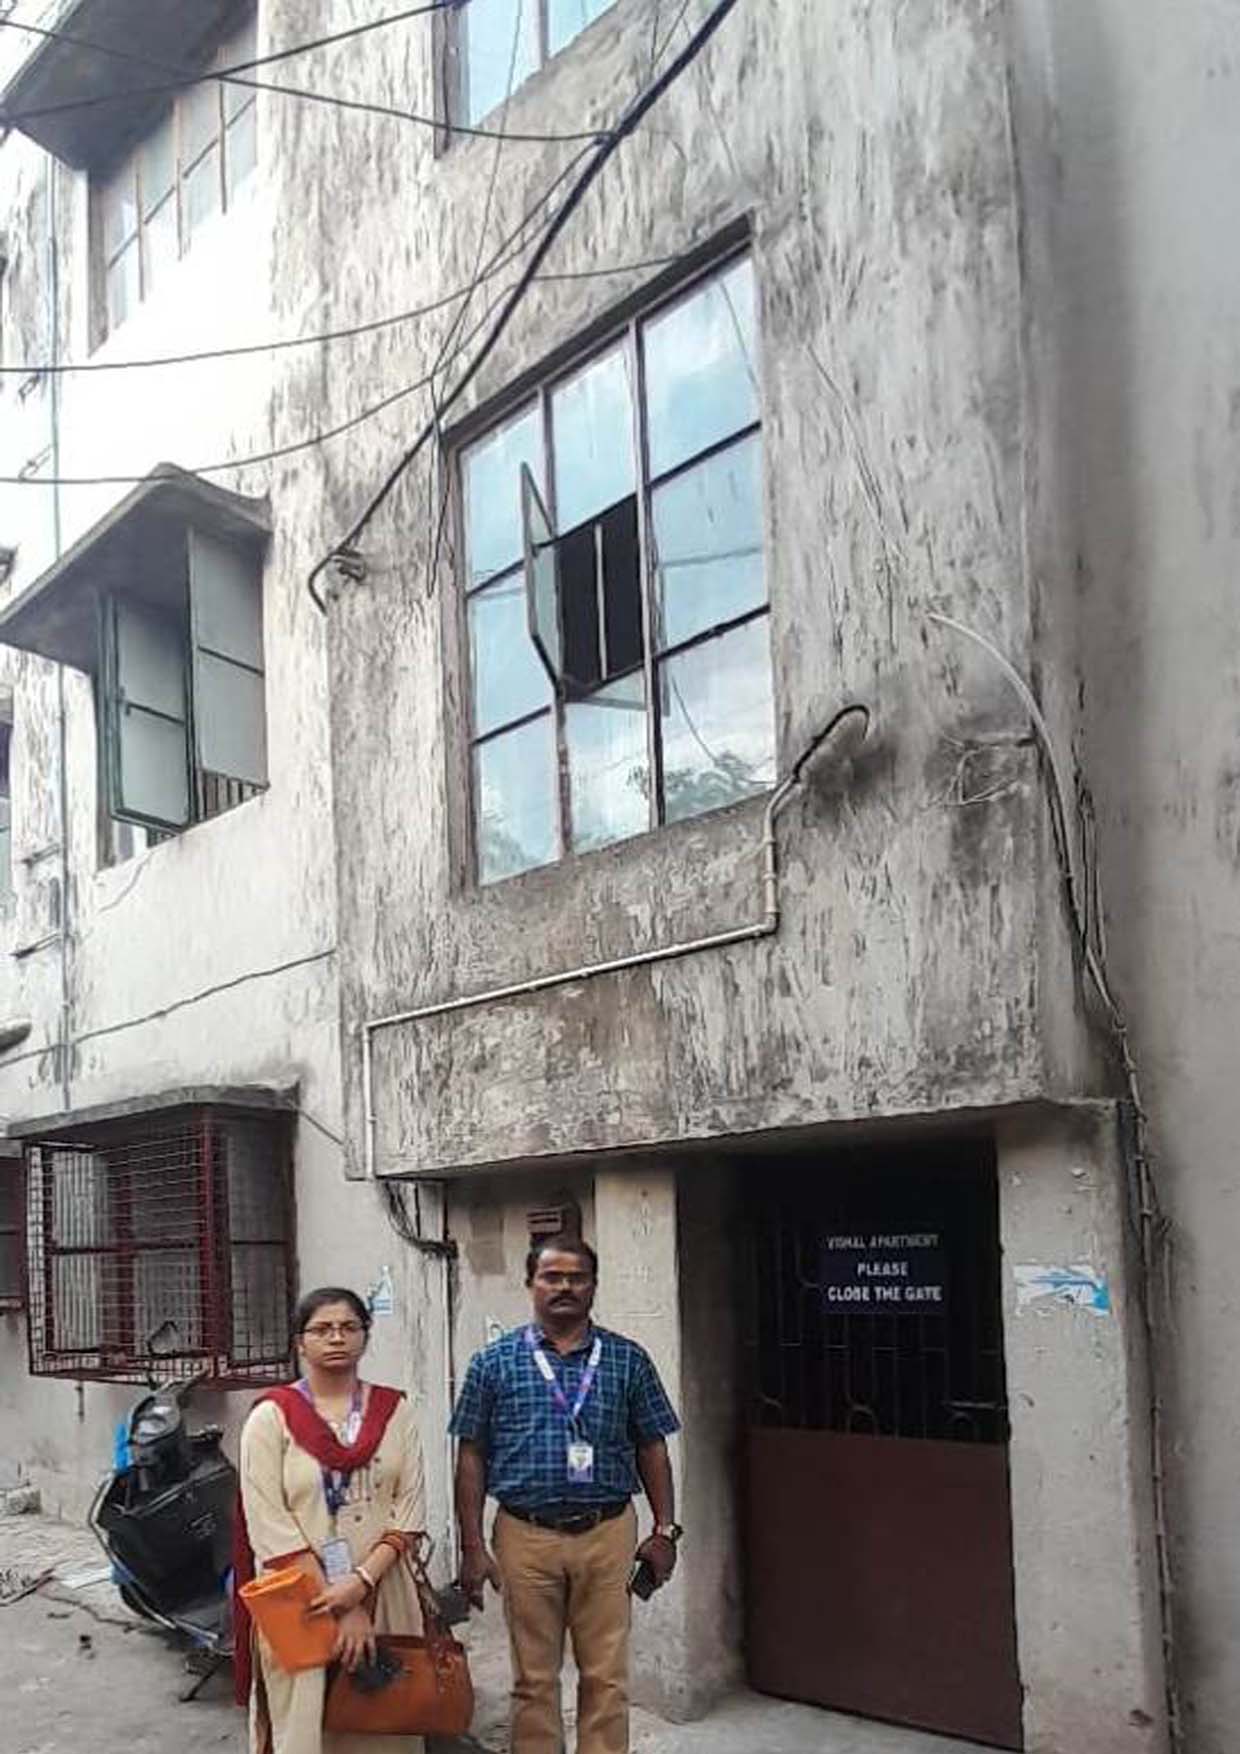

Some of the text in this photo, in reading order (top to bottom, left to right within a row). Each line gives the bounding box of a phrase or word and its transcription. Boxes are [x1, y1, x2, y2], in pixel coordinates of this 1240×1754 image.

[857, 1261, 909, 1276] PLEASE
[827, 1286, 943, 1301] CLOSE THE GATE
